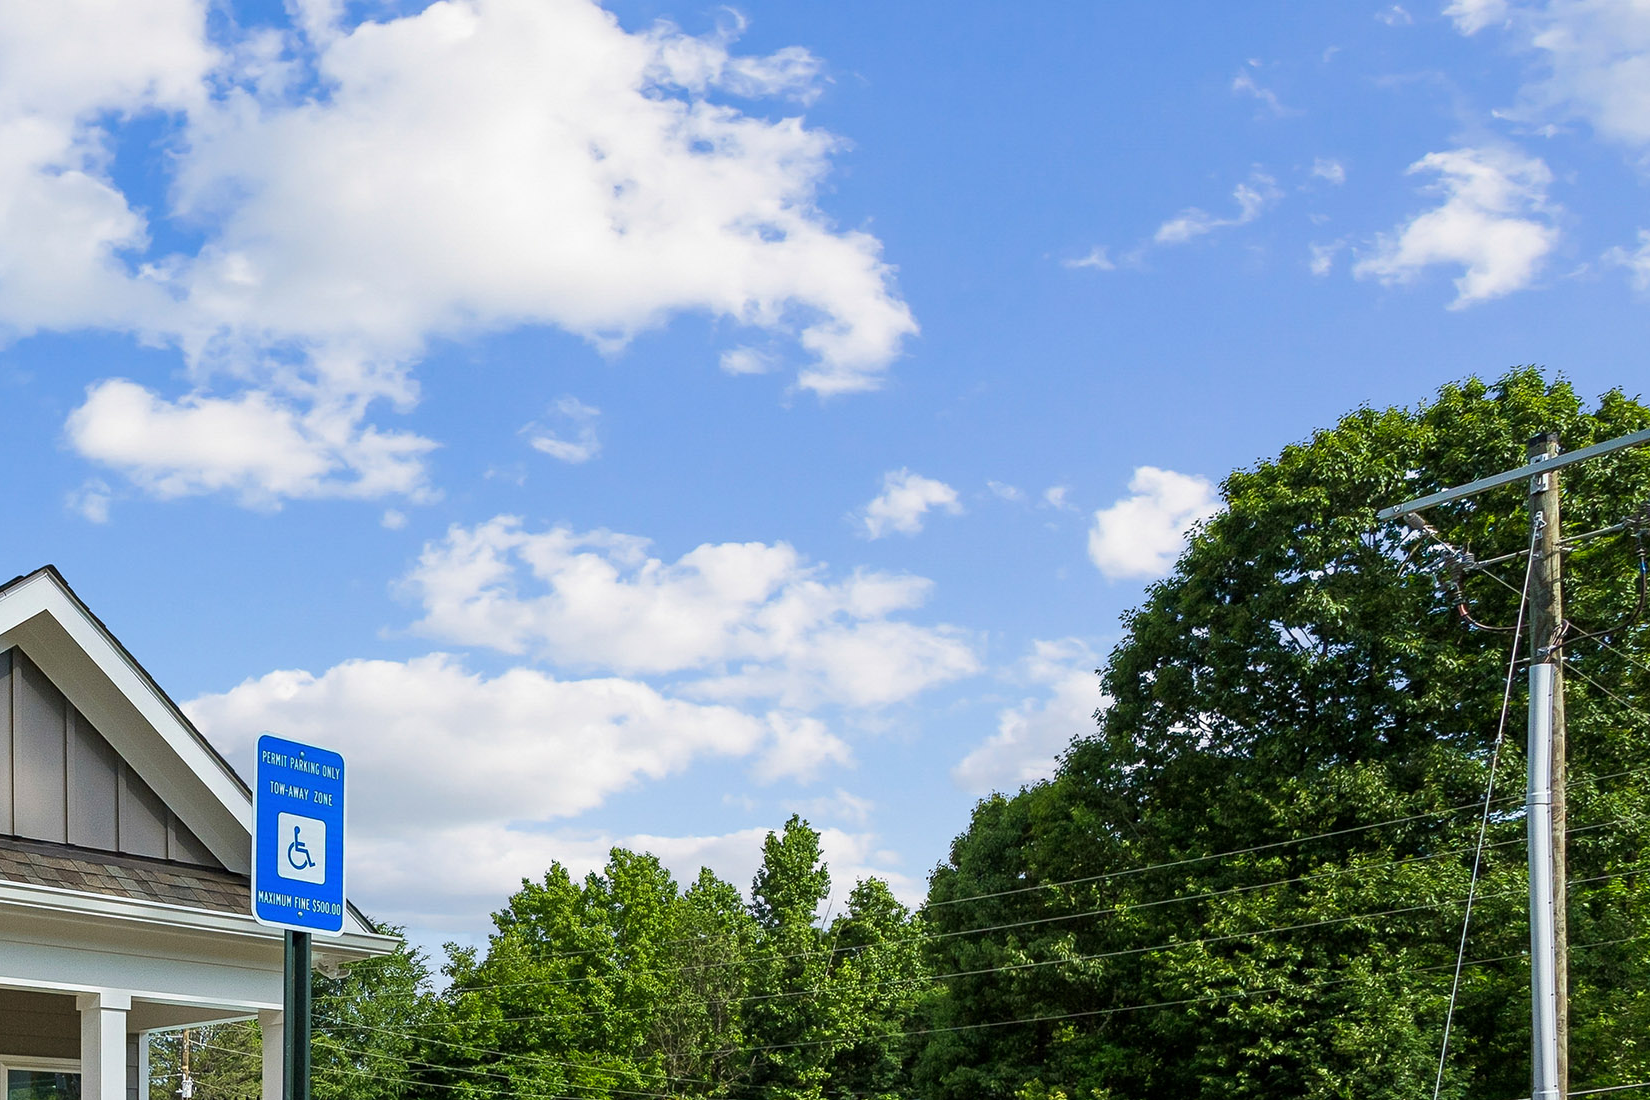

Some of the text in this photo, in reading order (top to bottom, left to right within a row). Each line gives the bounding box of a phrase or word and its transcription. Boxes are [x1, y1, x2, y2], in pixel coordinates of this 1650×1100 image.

[262, 750, 340, 780] PERMIT PARKING ONLY
[270, 780, 333, 806] TOW-AWAY ZONE
[258, 890, 341, 916] MAXIMUM FINE $500.00
